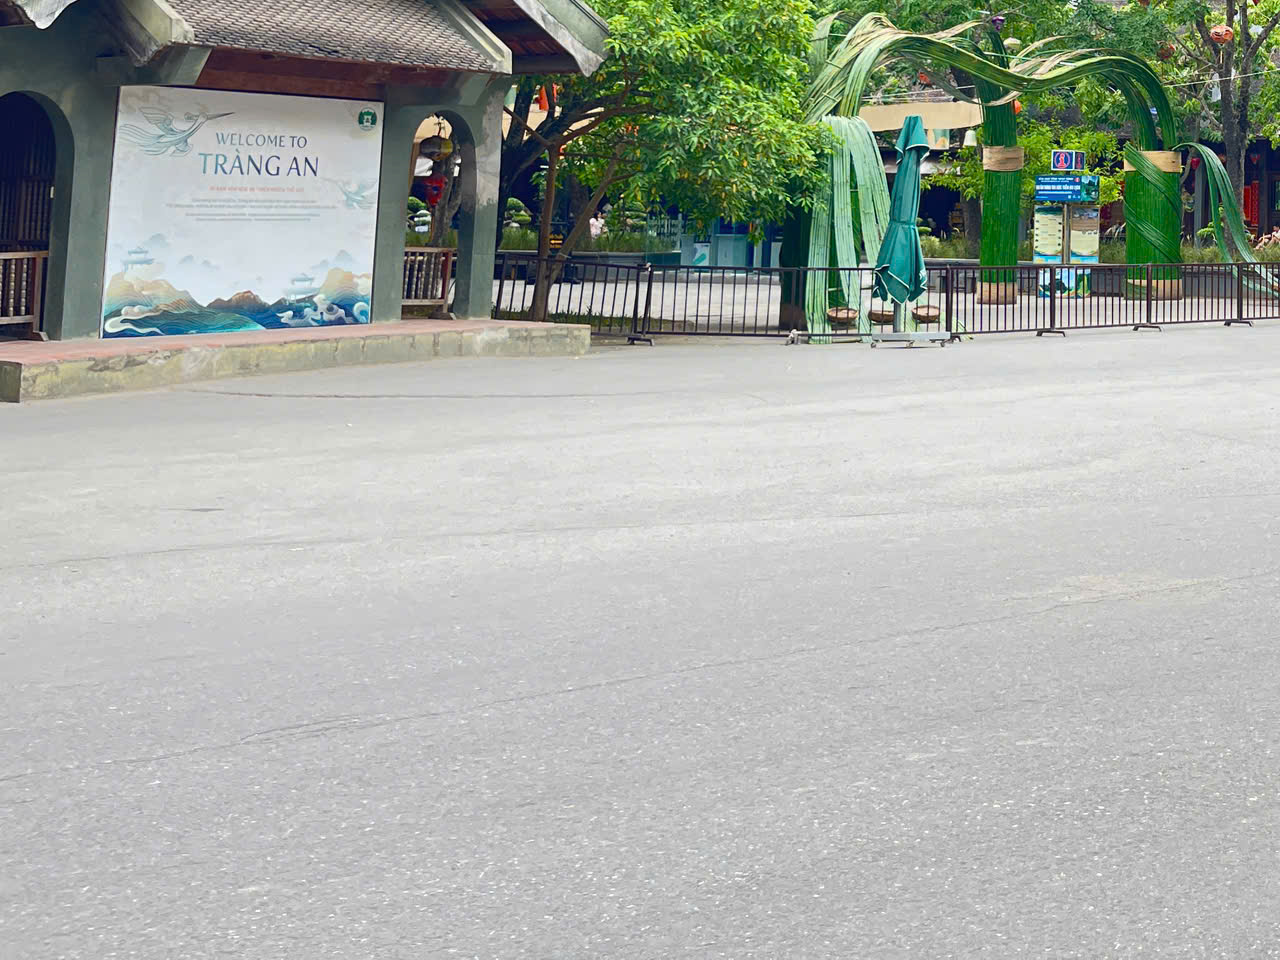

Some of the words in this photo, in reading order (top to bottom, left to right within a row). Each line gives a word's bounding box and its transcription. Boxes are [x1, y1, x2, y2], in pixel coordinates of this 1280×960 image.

[215, 132, 285, 147] WELCOME
[290, 136, 307, 148] TO
[198, 148, 281, 176] TRÀNG
[286, 156, 318, 176] AN
